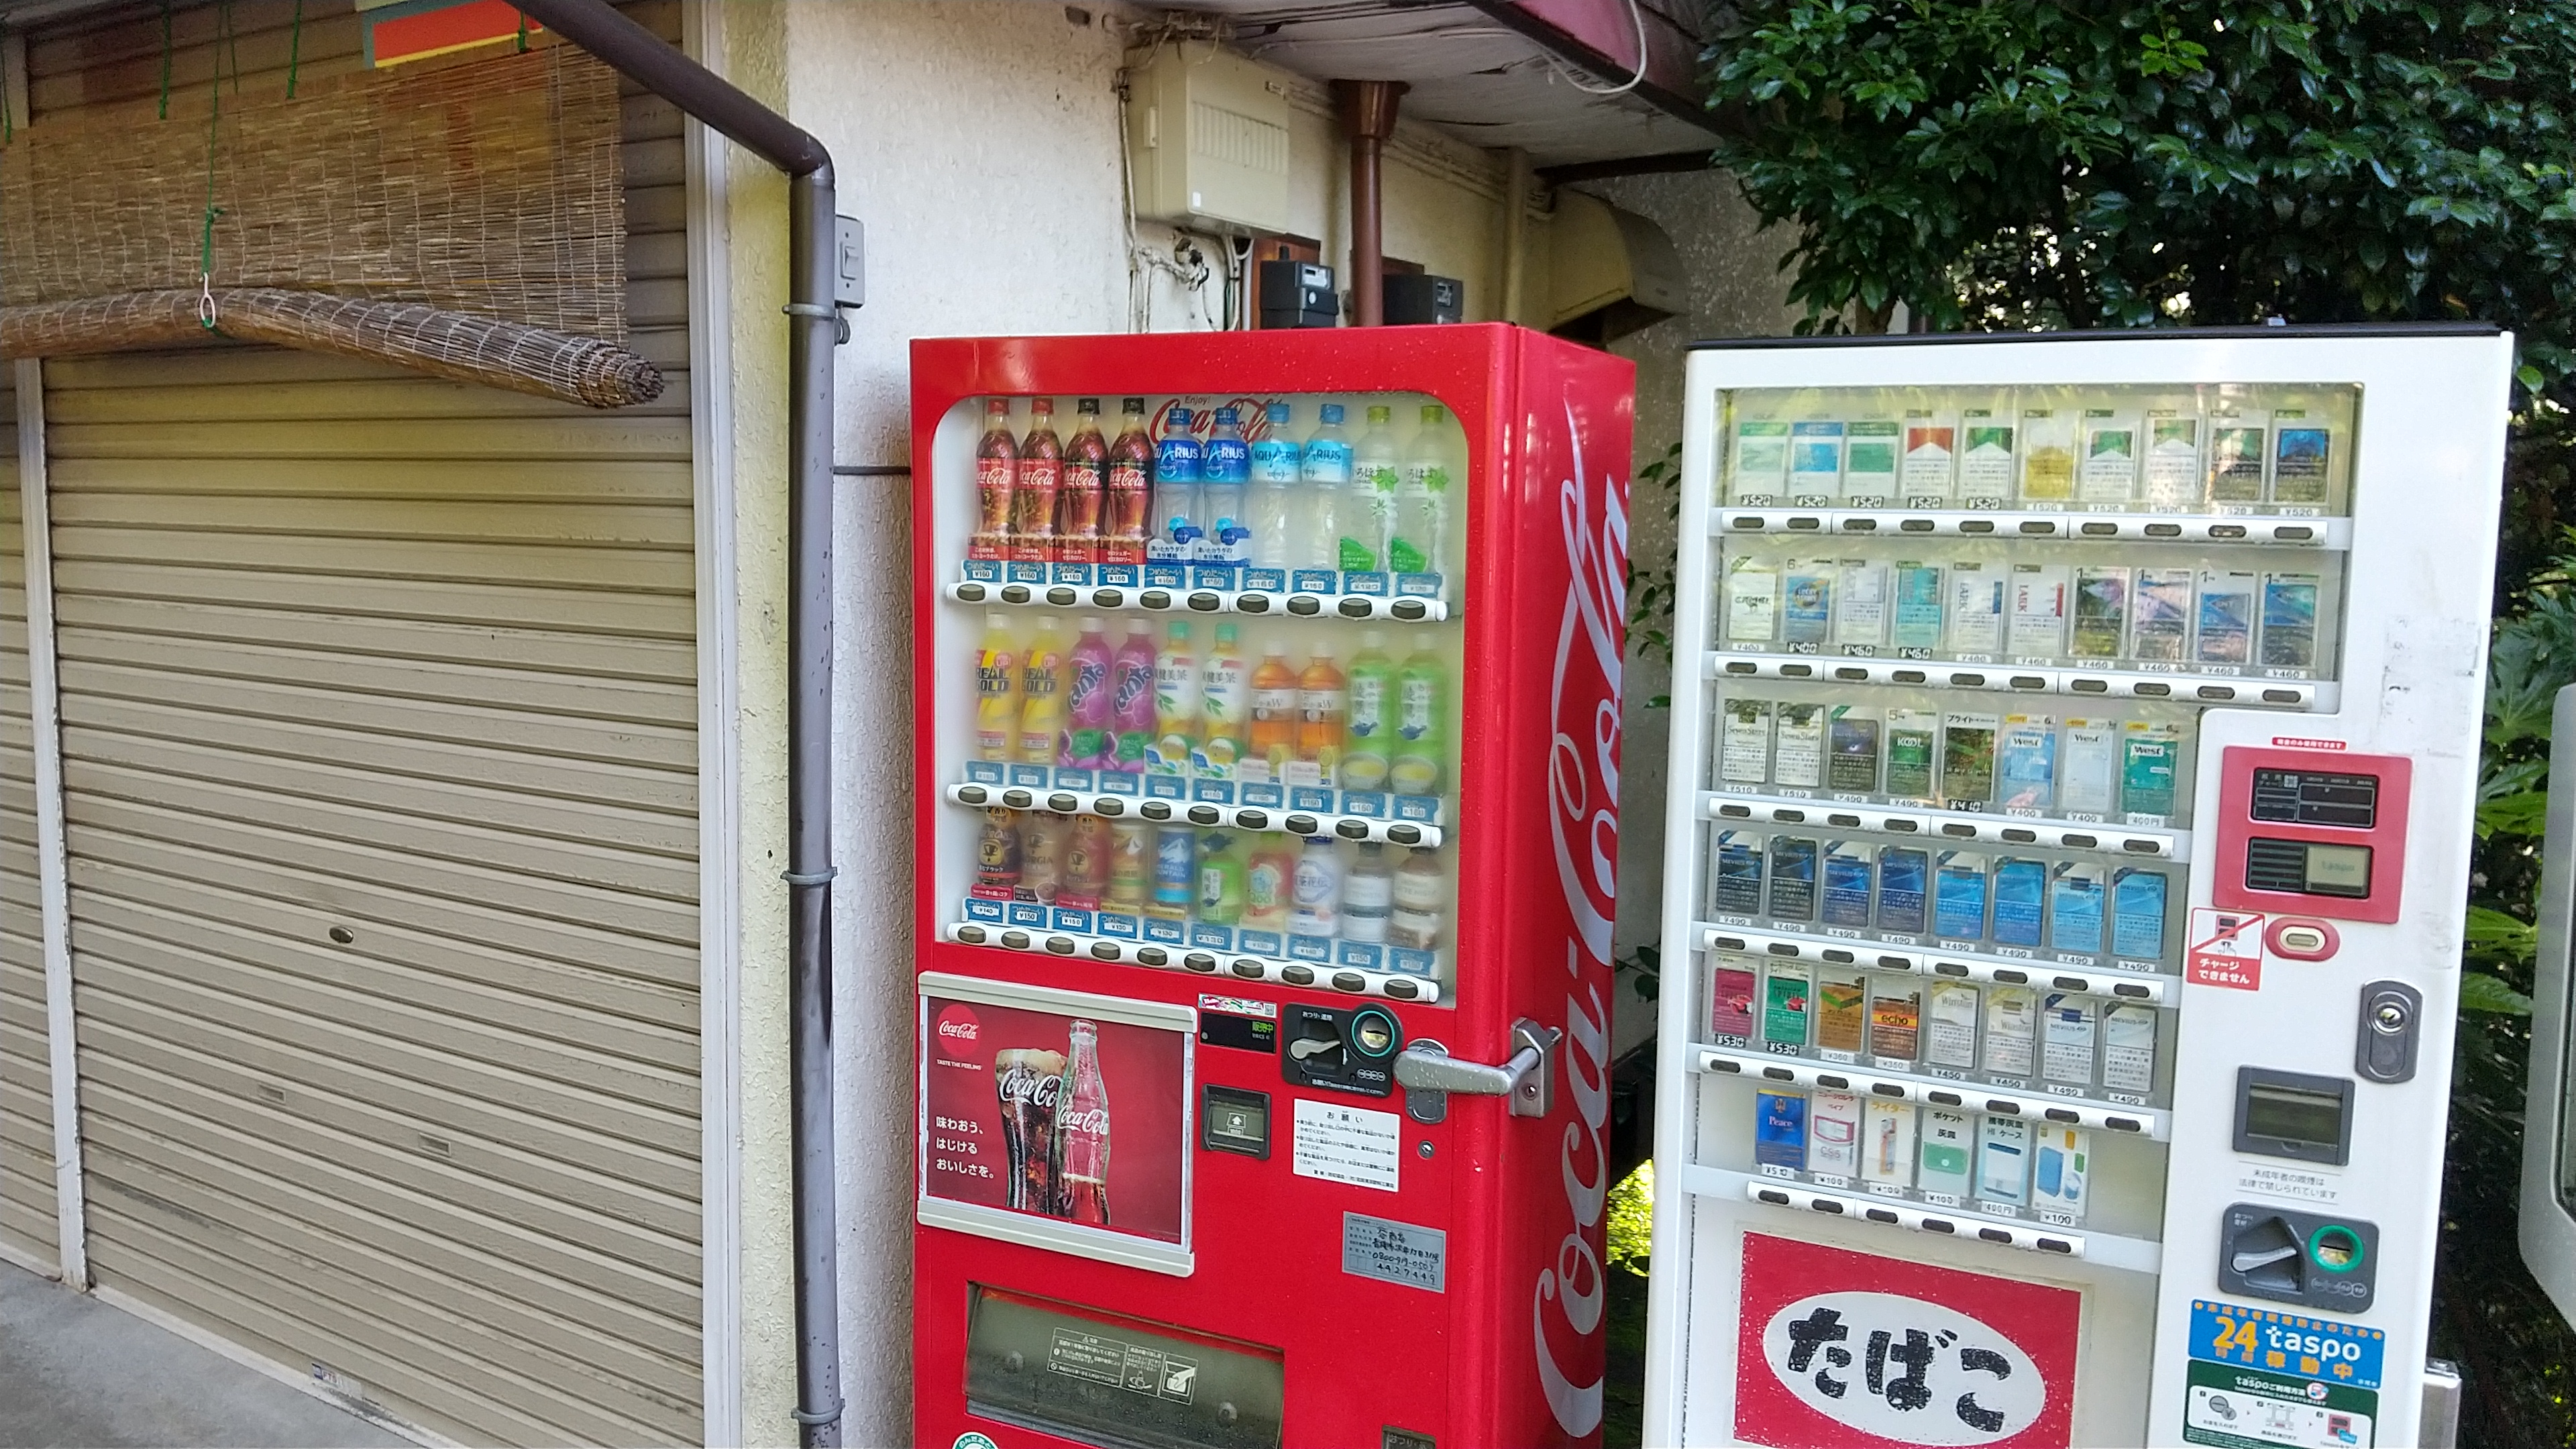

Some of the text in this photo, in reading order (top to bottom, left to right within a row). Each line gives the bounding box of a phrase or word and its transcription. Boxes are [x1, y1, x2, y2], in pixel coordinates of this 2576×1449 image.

[1149, 397, 1283, 444] Ca-Cola
[1741, 495, 1772, 506] ¥520
[1796, 496, 1827, 506] ¥520
[1851, 496, 1882, 507] ¥520
[1909, 497, 1941, 508] ¥520
[1968, 498, 2000, 509] ¥520
[2093, 504, 2119, 513] ¥520
[2286, 507, 2312, 516] ¥520
[2018, 584, 2028, 612] LARK
[1788, 642, 1817, 653] ¥400
[1843, 645, 1874, 656] ¥460
[1900, 648, 1931, 659] ¥460
[2021, 658, 2046, 666] ¥460
[2082, 660, 2108, 669] ¥460
[2144, 663, 2170, 672] ¥460
[2206, 667, 2233, 675] ¥460
[2272, 669, 2300, 678] ¥460
[1947, 714, 1974, 724] ブライト
[1896, 736, 1923, 748] KOOL
[2013, 737, 2041, 747] West
[2074, 733, 2100, 743] West
[2133, 745, 2161, 755] West
[1729, 785, 1752, 794] ¥510
[1784, 789, 1806, 798] ¥510
[1838, 794, 1862, 803] ¥490
[1894, 799, 1918, 808] ¥490
[1350, 804, 1373, 812] ¥160
[1950, 800, 1980, 812] ¥410
[2012, 809, 2036, 818] ¥400
[2071, 814, 2097, 822] ¥400
[2133, 817, 2159, 826] 400円
[1532, 396, 1629, 1441] Coca-Cola
[1724, 916, 1746, 925] ¥490
[1778, 922, 1801, 932] ¥490
[1833, 928, 1856, 938] ¥490
[1887, 934, 1911, 945] ¥490
[1946, 943, 1970, 952] ¥490
[1350, 955, 1368, 963] ¥150
[2002, 949, 2027, 959] ¥490
[2063, 955, 2088, 965] ¥490
[2199, 958, 2240, 971] チャージ
[2125, 961, 2150, 972] ¥490
[2198, 969, 2250, 984] できません
[1941, 996, 1973, 1008] Winston
[1880, 1014, 1909, 1026] echo
[938, 1020, 979, 1040] Coca-Cola
[2000, 1019, 2032, 1033] Winston
[1716, 1034, 1745, 1048] ¥530
[1768, 1042, 1799, 1055] ¥530
[1827, 1053, 1848, 1061] ¥360
[936, 1059, 951, 1067] TASTE
[961, 1063, 981, 1071] FEELING
[1882, 1061, 1903, 1069] ¥350
[1937, 1071, 1961, 1081] ¥450
[1000, 1069, 1063, 1107] Coca-Co
[1996, 1077, 2021, 1088] ¥450
[2053, 1086, 2078, 1097] ¥490
[2114, 1095, 2139, 1106] ¥490
[1871, 1100, 1911, 1113] ライター
[1768, 1116, 1793, 1127] Peace
[1933, 1111, 1964, 1124] ポケット
[1988, 1116, 2024, 1129] 携帯灰皿
[936, 1116, 983, 1135] 味わおう、
[1937, 1129, 1957, 1140] 灰皿
[1987, 1128, 2023, 1140] HI ケース
[936, 1138, 978, 1155] はじける
[936, 1159, 995, 1179] おいしさを。
[1766, 1165, 1788, 1177] ¥510
[1819, 1175, 1843, 1186] ¥100
[2253, 1169, 2325, 1187] 未成年者の喫煙は
[2238, 1178, 2338, 1199] 法律で禁じられています
[1929, 1195, 1953, 1204] ¥100
[1986, 1203, 2012, 1214] 400円
[2045, 1215, 2072, 1225] ¥100
[2213, 1316, 2259, 1352] 24
[2265, 1325, 2361, 1362] taspo
[1787, 1306, 2012, 1434] たばこ
